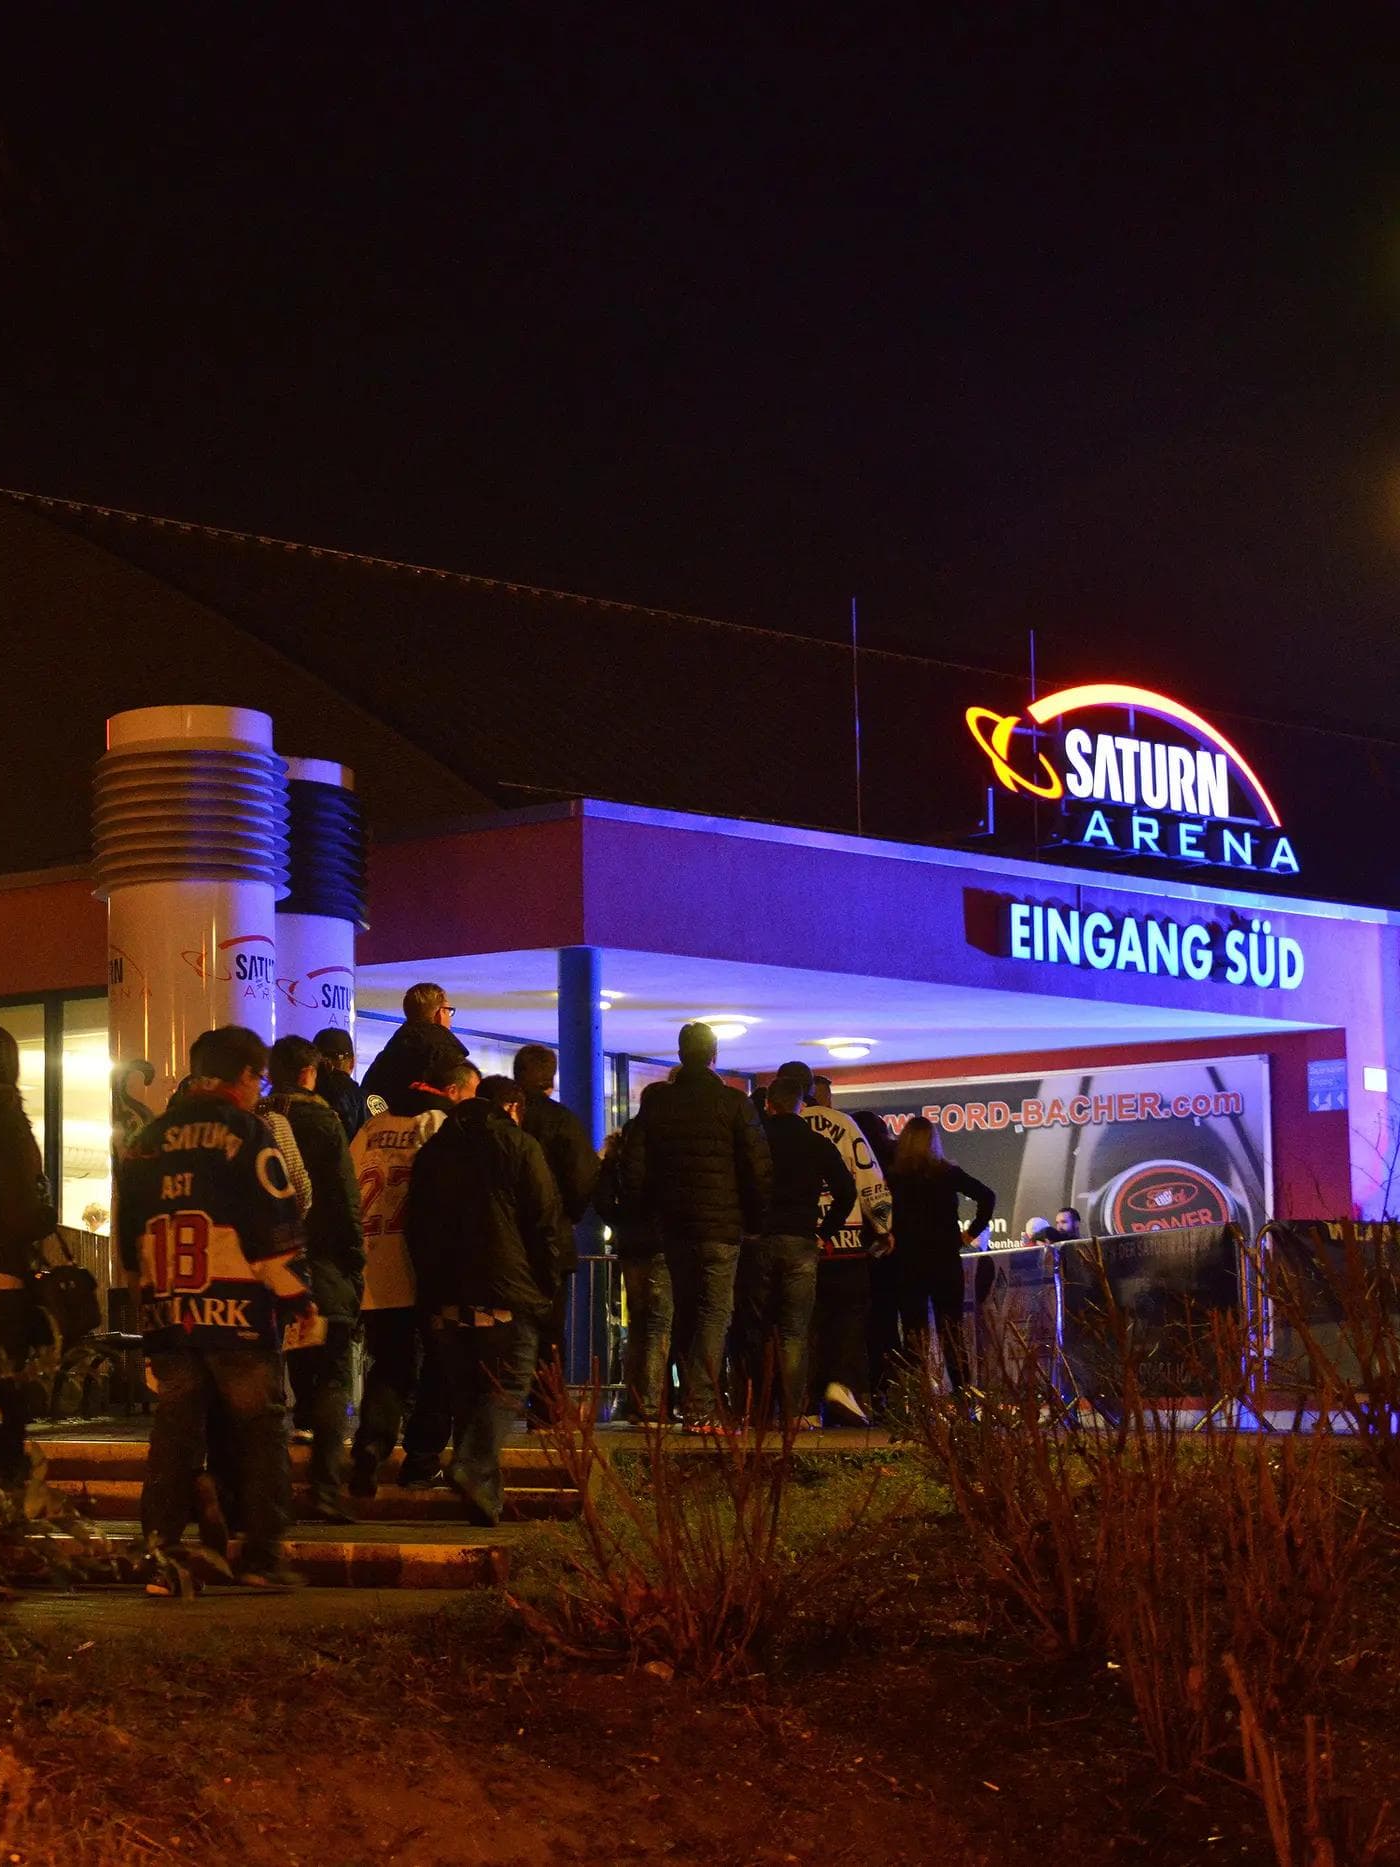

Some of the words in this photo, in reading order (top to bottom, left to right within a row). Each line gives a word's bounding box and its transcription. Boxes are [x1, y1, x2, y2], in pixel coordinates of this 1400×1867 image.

[1065, 728, 1229, 818] SATURN
[1082, 810, 1300, 872] ARENA
[1011, 903, 1213, 981] EINGANG
[1225, 918, 1305, 990] SÜD
[805, 1114, 846, 1144] TURN
[145, 1208, 214, 1298] 18
